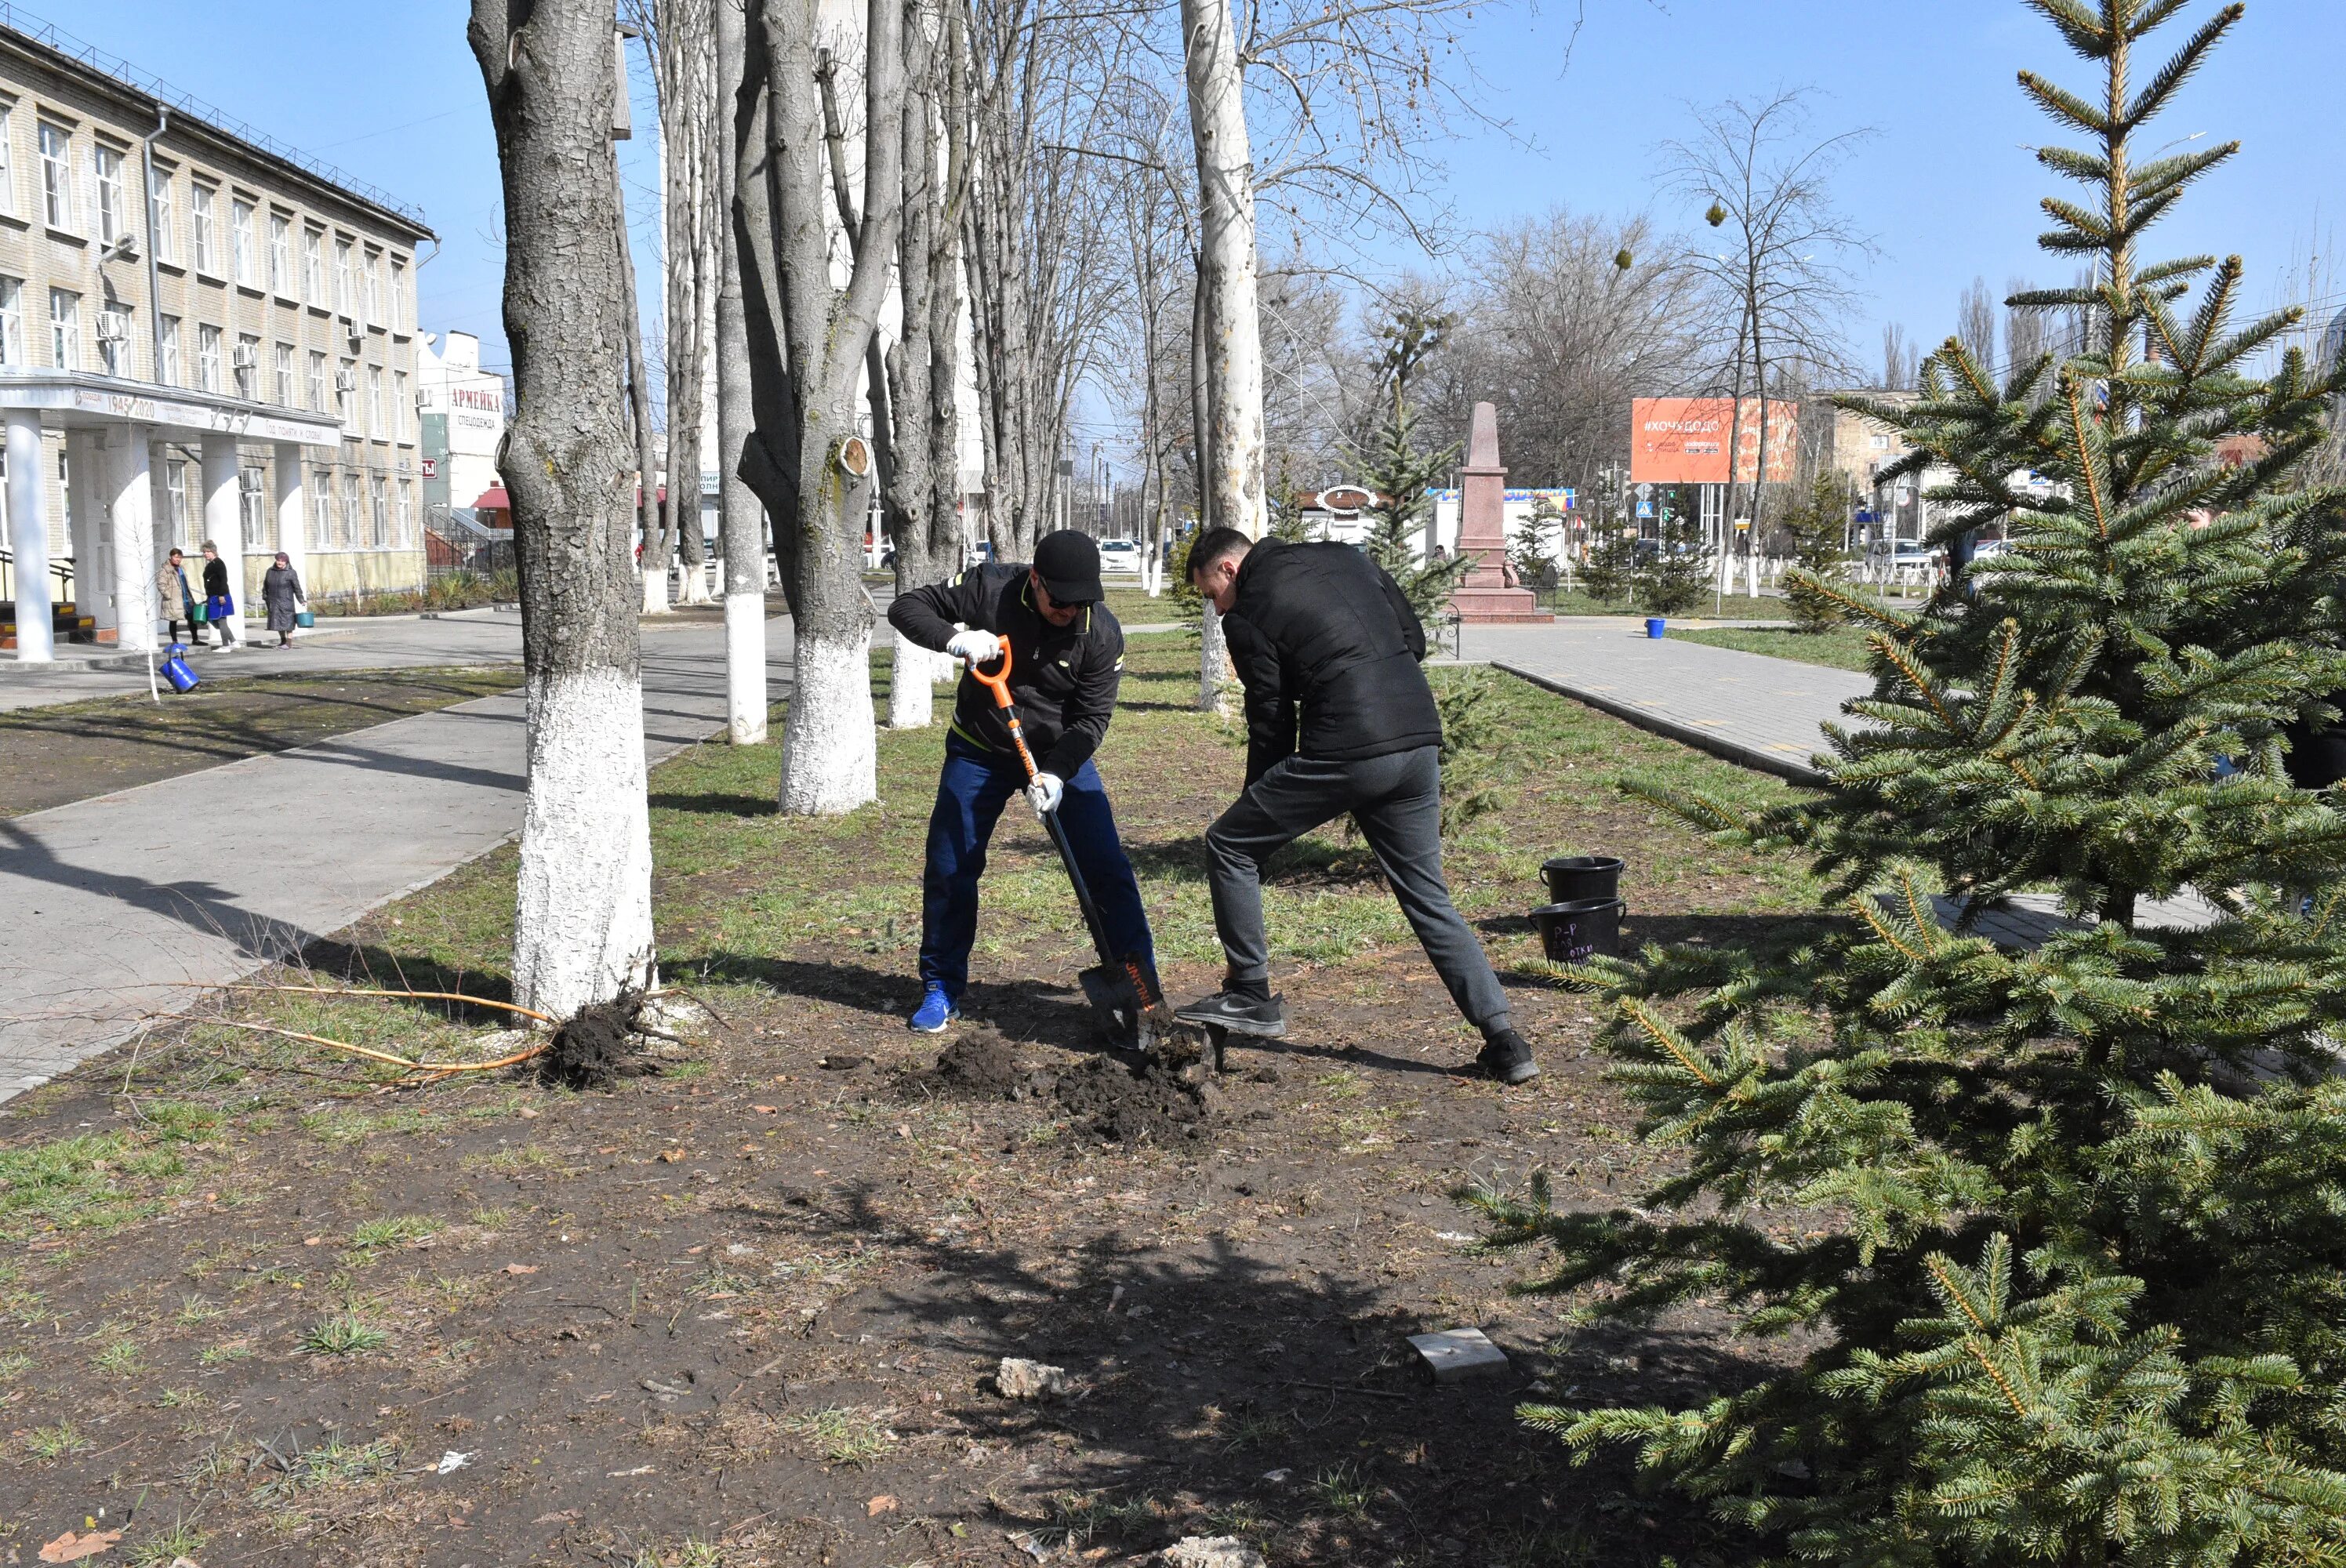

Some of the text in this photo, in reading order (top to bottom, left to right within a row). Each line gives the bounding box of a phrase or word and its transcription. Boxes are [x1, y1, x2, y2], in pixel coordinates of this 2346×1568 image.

[135, 399, 155, 419] 2020
[452, 388, 500, 413] АРМЕЙКА
[266, 419, 275, 434] Год
[458, 415, 496, 430] СПЕЦОДЕЖДА
[1644, 421, 1720, 432] #ХОЧУДОДО
[1015, 738, 1036, 777] FINLAND
